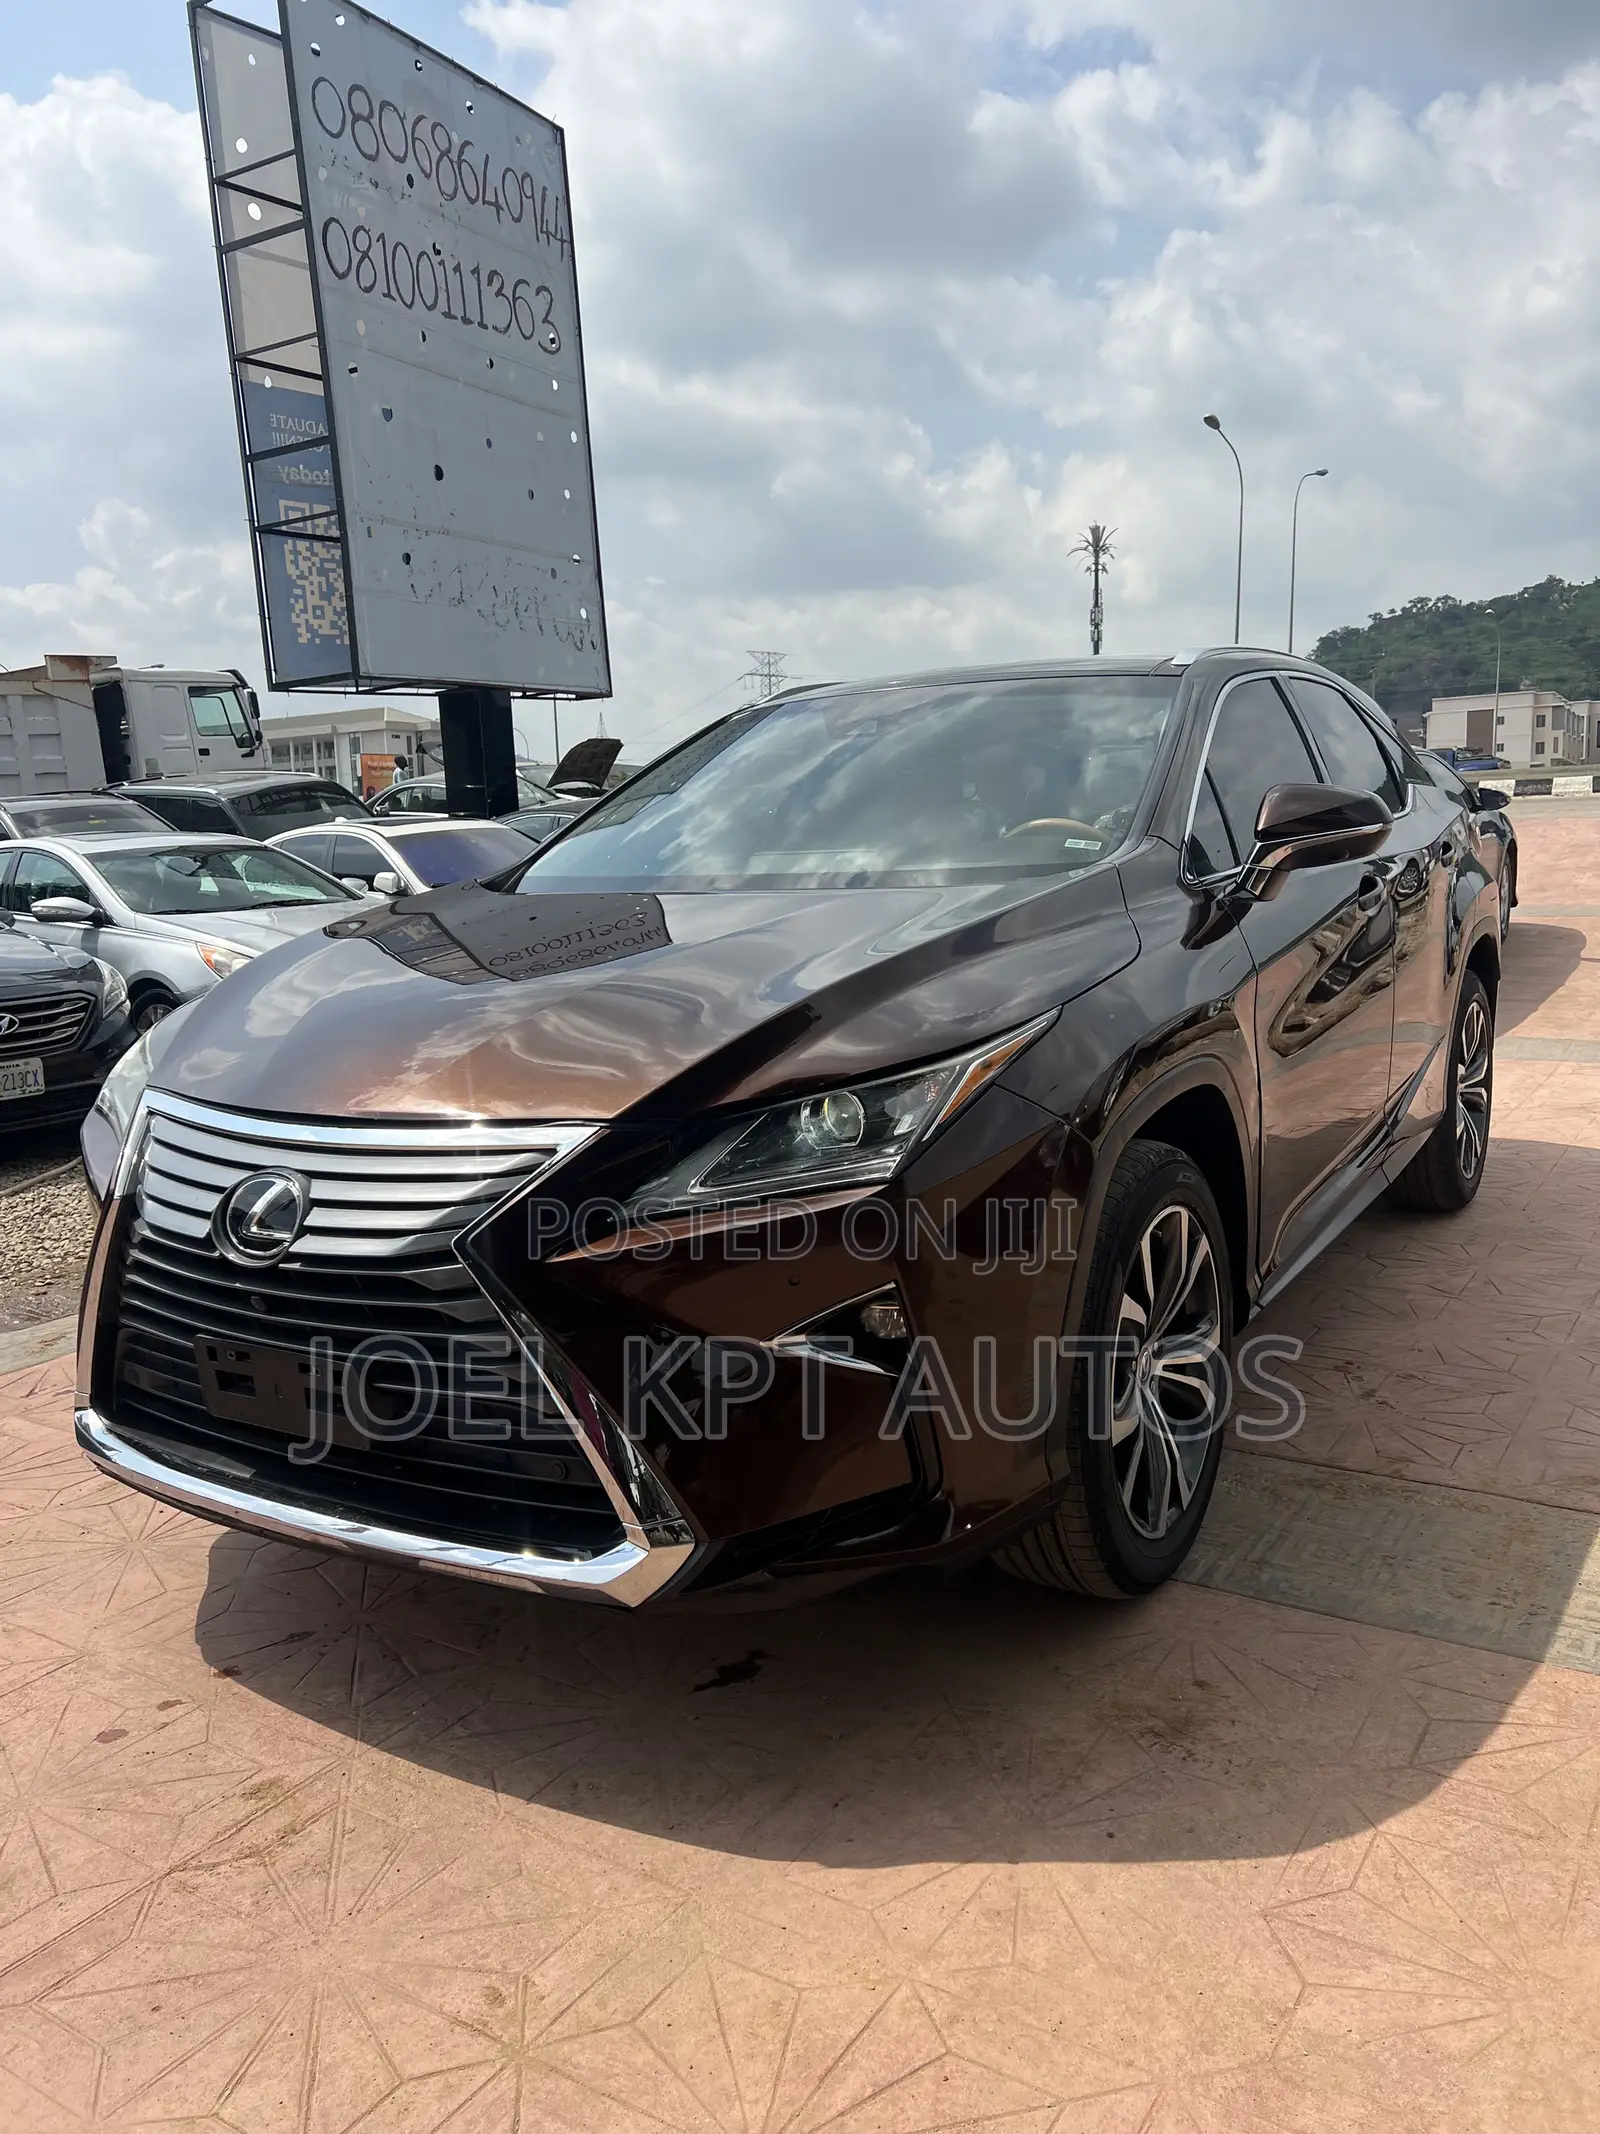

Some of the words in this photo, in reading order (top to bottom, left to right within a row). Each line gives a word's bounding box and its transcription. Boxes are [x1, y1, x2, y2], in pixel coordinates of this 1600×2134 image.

[311, 76, 571, 261] 08068640944
[322, 217, 561, 355] 08100111363
[0, 1069, 40, 1091] 213CX
